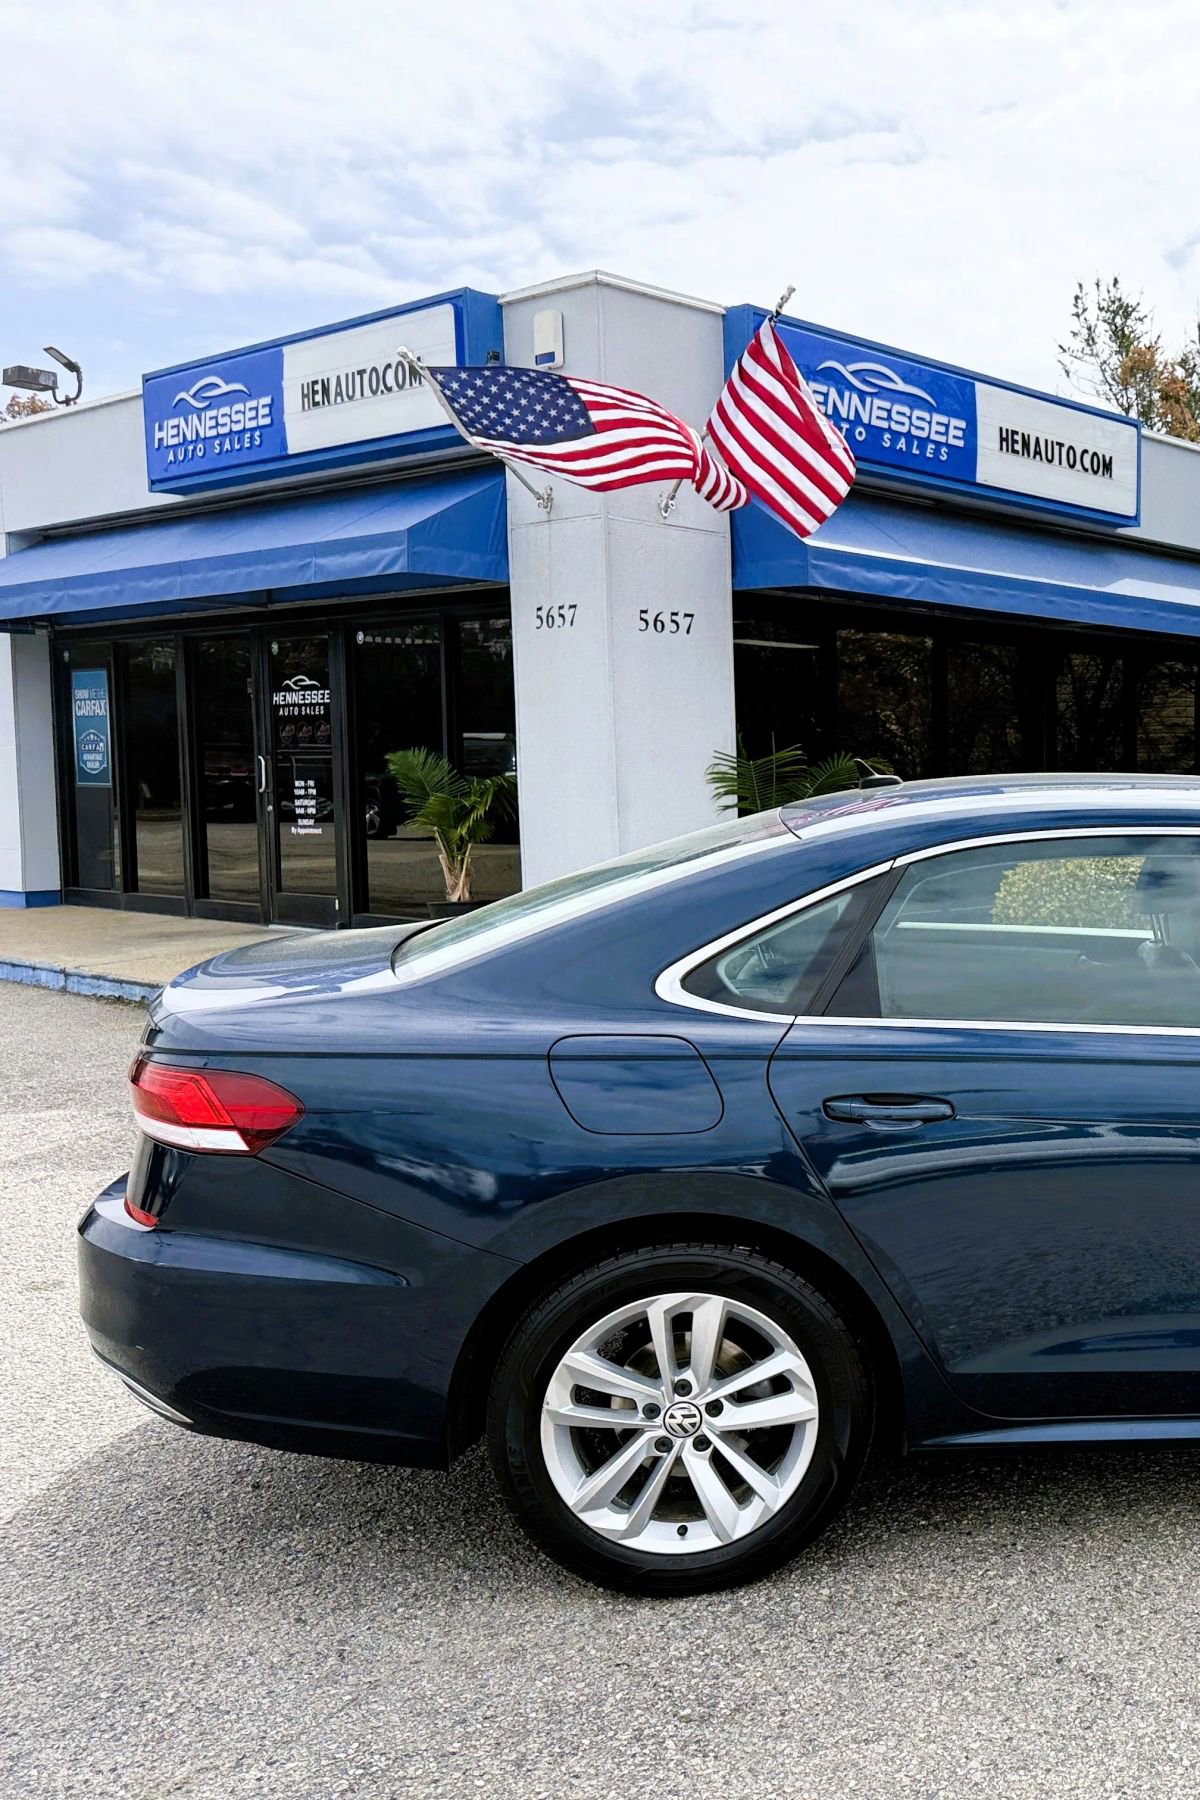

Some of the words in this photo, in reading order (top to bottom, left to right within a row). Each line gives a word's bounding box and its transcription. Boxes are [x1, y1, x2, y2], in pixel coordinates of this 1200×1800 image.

[154, 395, 272, 449] HENNESSEE
[807, 381, 967, 448] ENNESSEE
[167, 443, 204, 463] AUTO
[214, 430, 262, 454] SALES
[882, 432, 949, 462] SALES
[535, 603, 578, 630] 5657
[638, 608, 695, 635] 5657
[75, 700, 106, 717] CARFAX
[272, 690, 331, 705] HENNESSEE
[279, 706, 299, 716] AUTO
[301, 705, 325, 716] SALES
